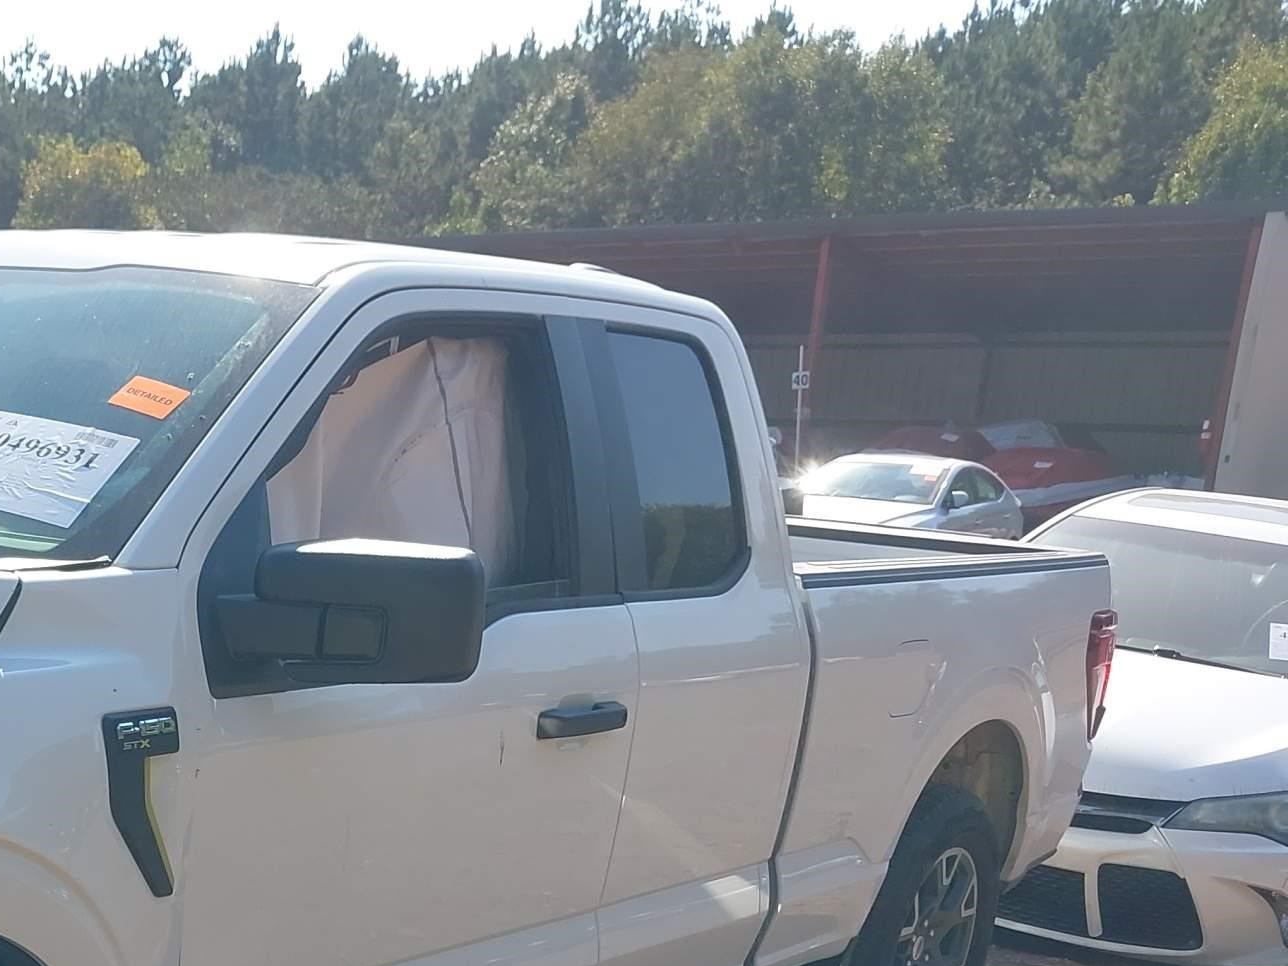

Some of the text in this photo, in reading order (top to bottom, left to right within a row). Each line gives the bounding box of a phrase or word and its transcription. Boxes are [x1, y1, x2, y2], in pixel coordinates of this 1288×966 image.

[793, 374, 809, 386] 40
[126, 387, 173, 406] DETAILED
[123, 739, 151, 751] STX
